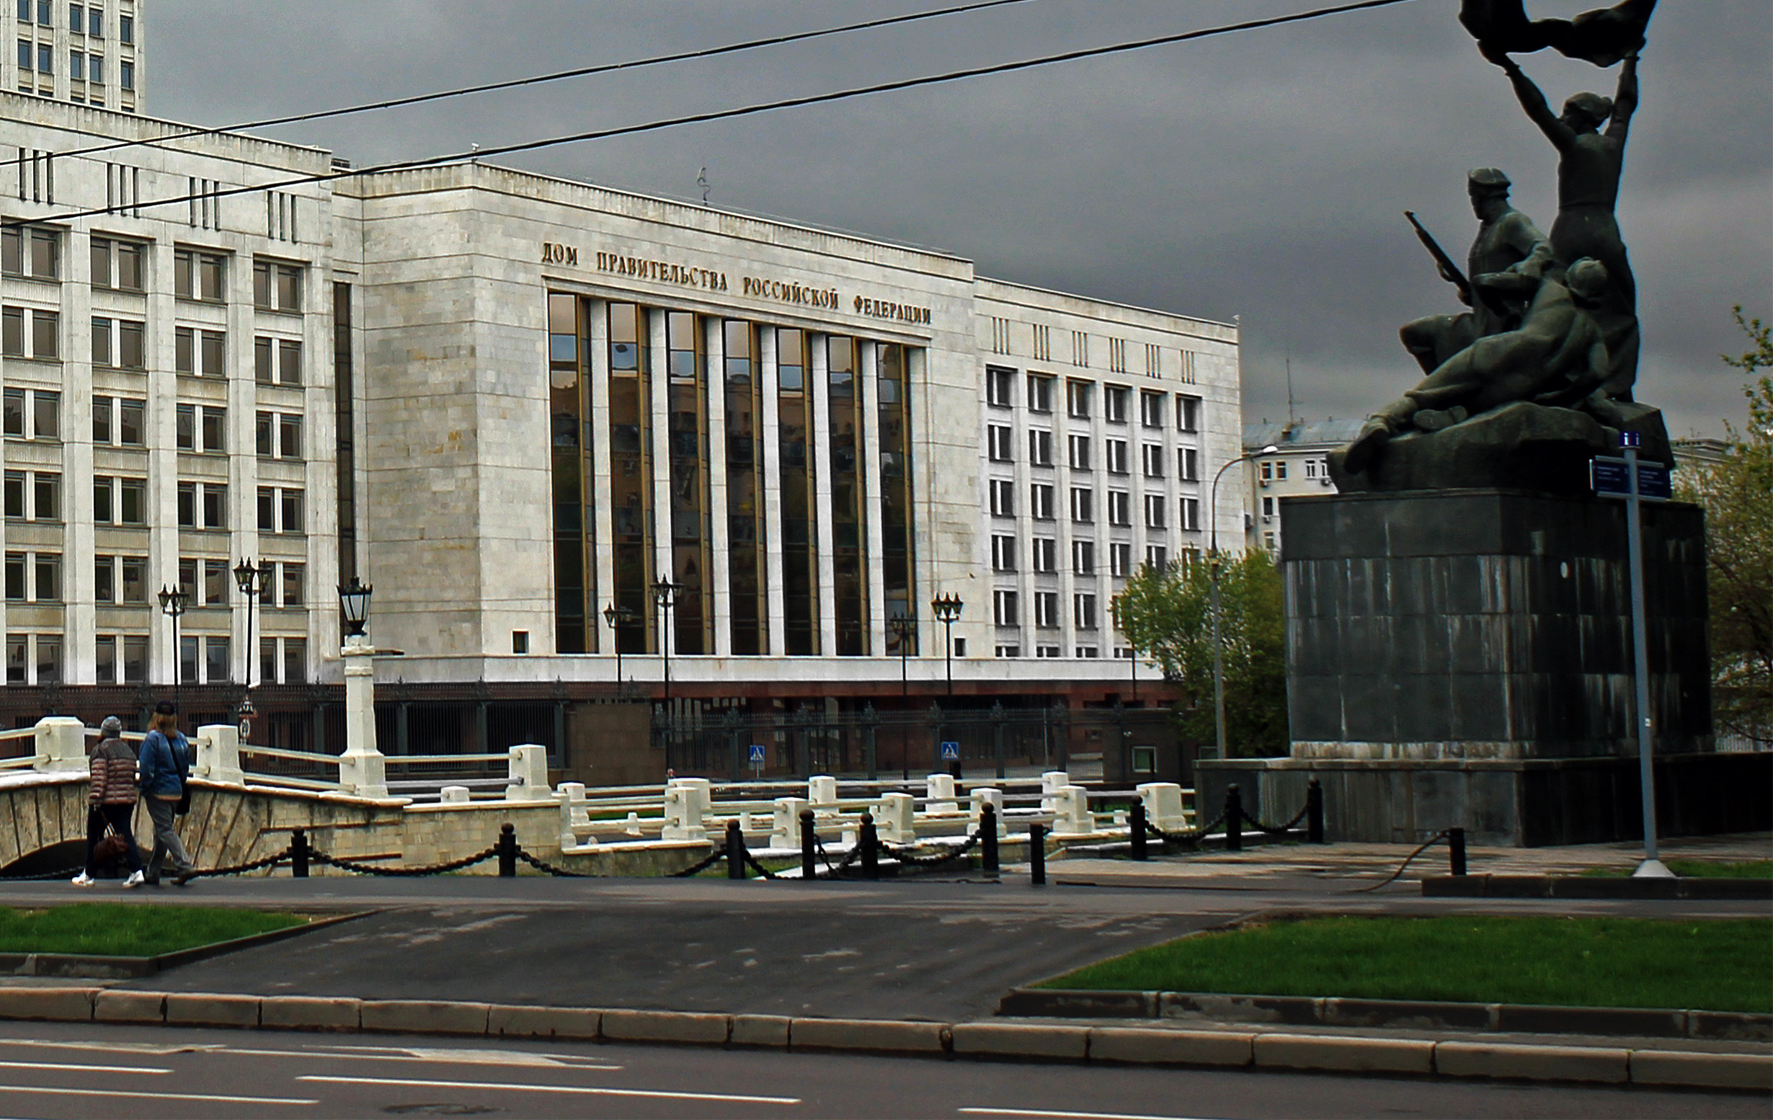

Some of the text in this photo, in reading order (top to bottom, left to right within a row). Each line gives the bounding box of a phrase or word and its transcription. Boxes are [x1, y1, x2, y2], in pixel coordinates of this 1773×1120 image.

[541, 242, 932, 325] ДОМ ПРАВИТЕЛЬСТВА РОССИЙСКОЙ ФЕДЕРАЦИИ
